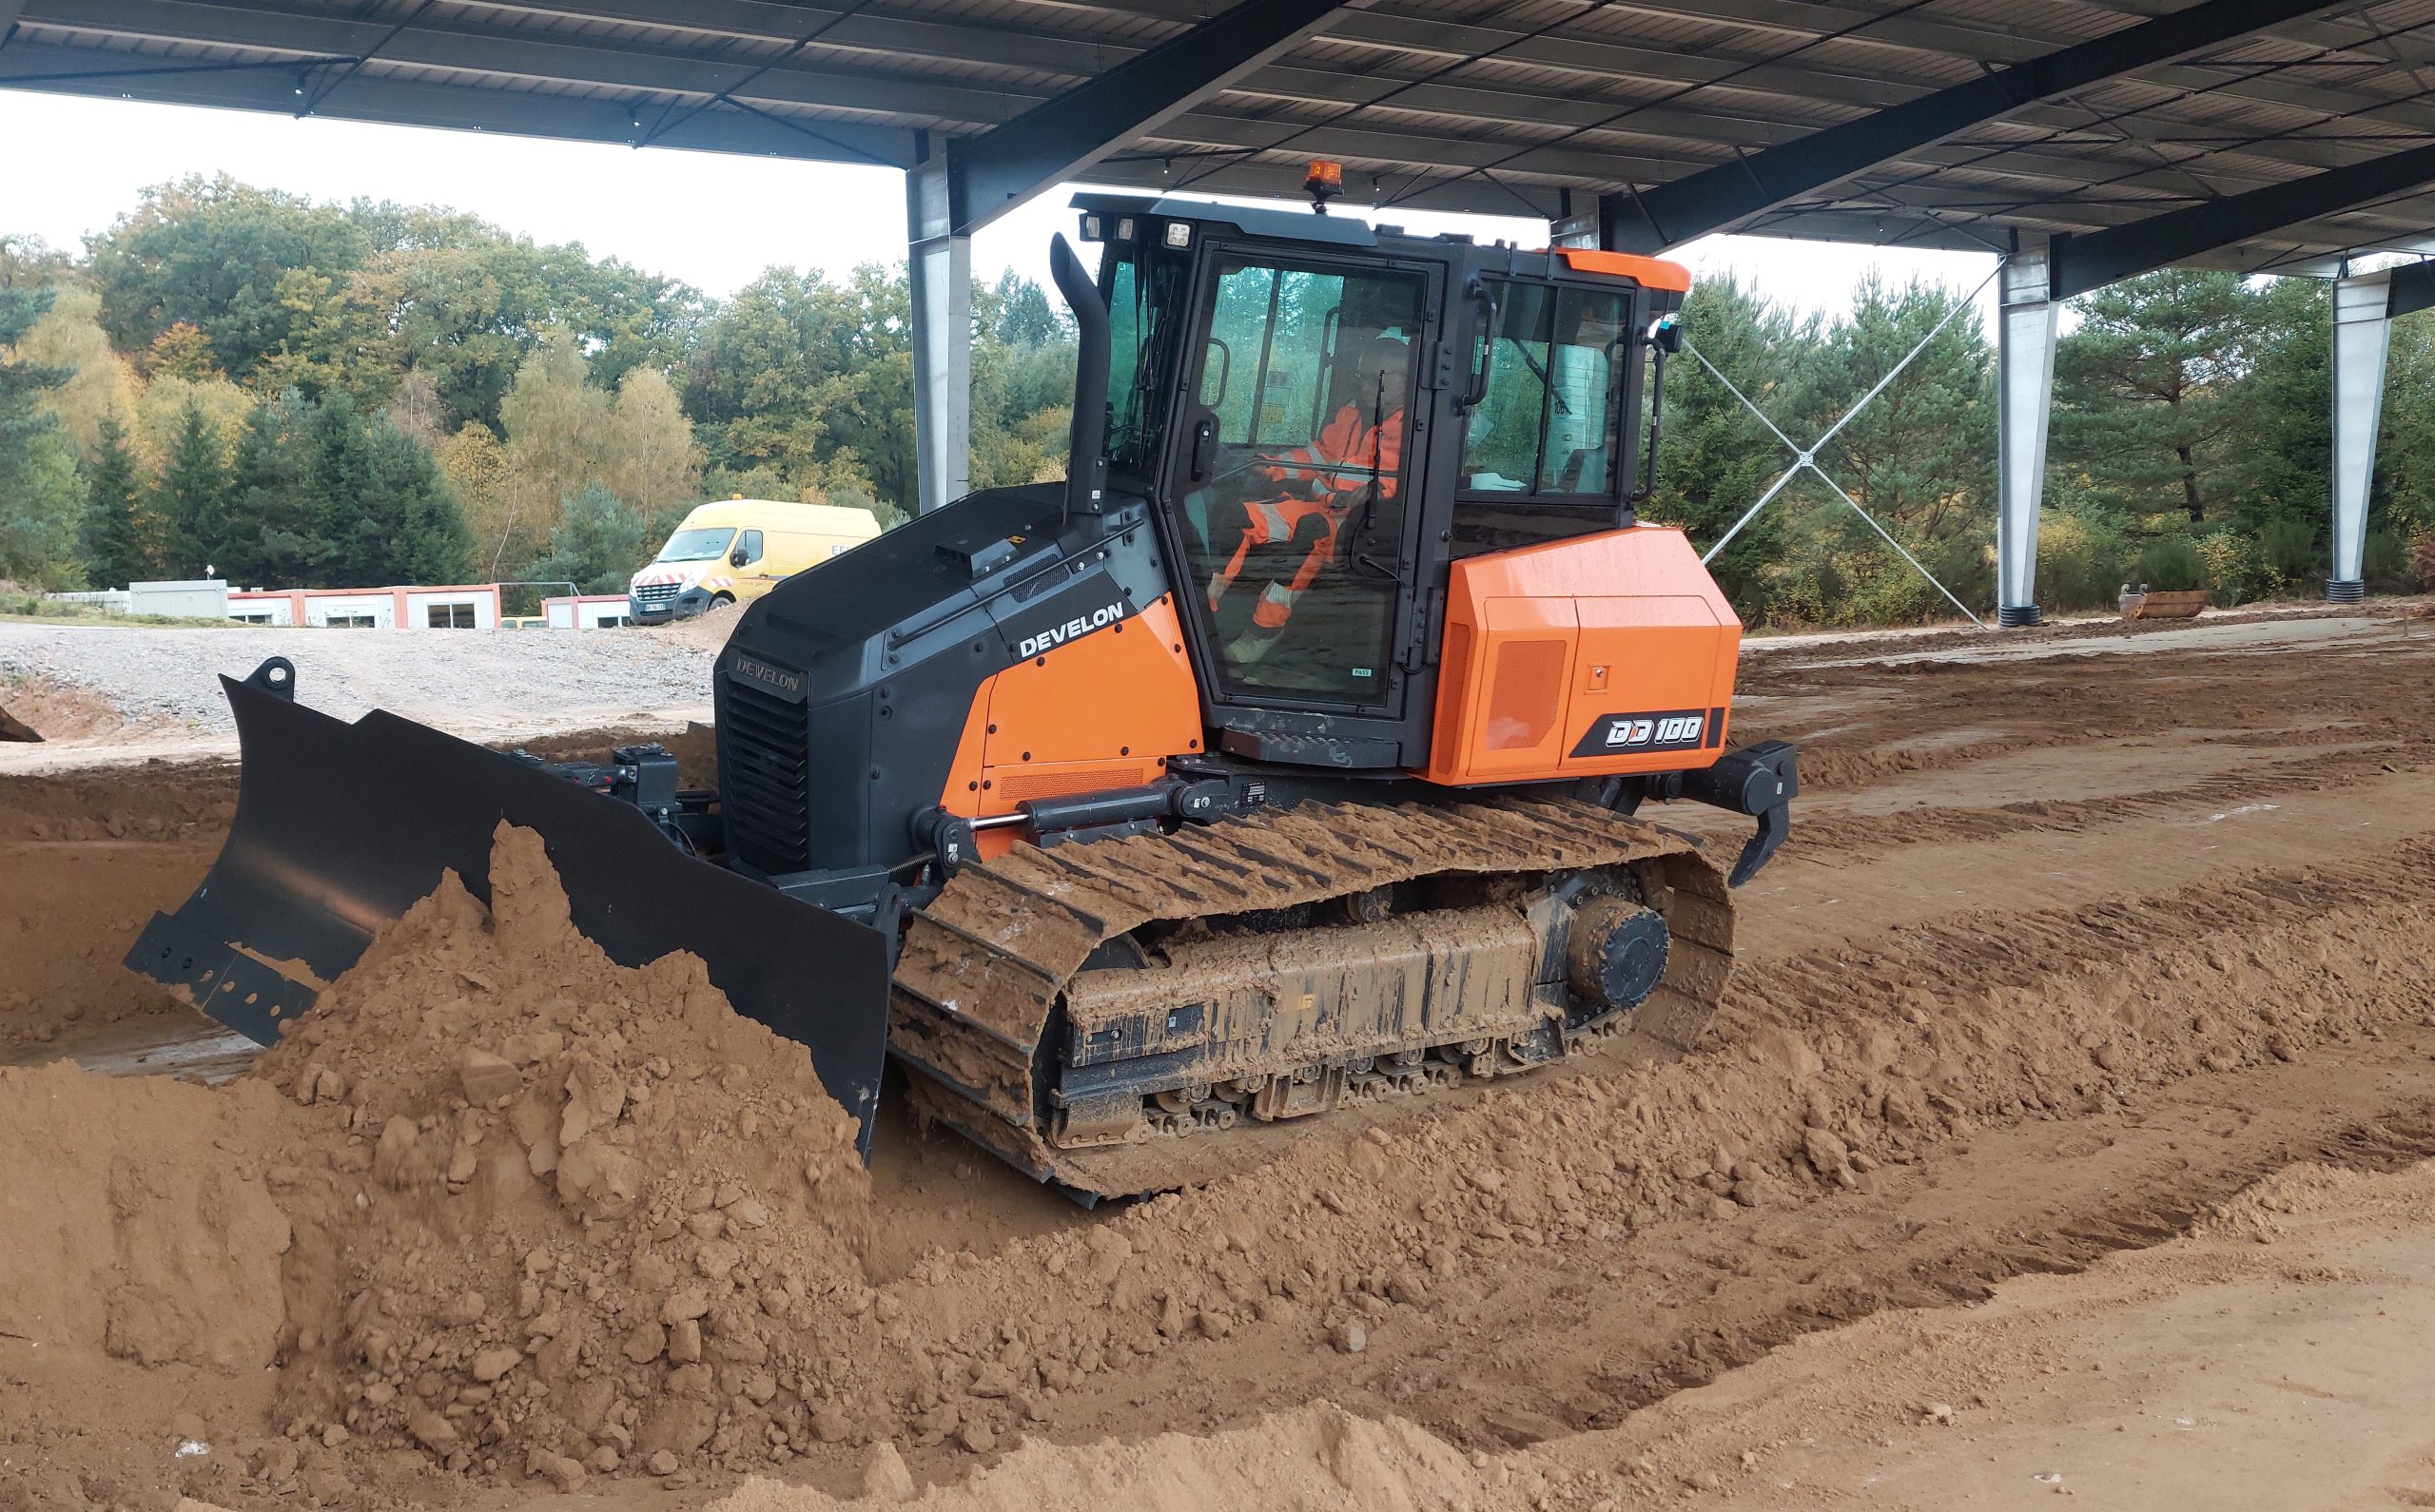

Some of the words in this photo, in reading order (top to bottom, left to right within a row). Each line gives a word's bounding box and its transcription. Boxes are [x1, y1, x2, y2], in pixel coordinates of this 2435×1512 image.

[1020, 602, 1123, 657] DEVELON
[736, 657, 799, 691] DEVELON
[1606, 720, 1655, 747] DD
[1654, 716, 1704, 744] 100
